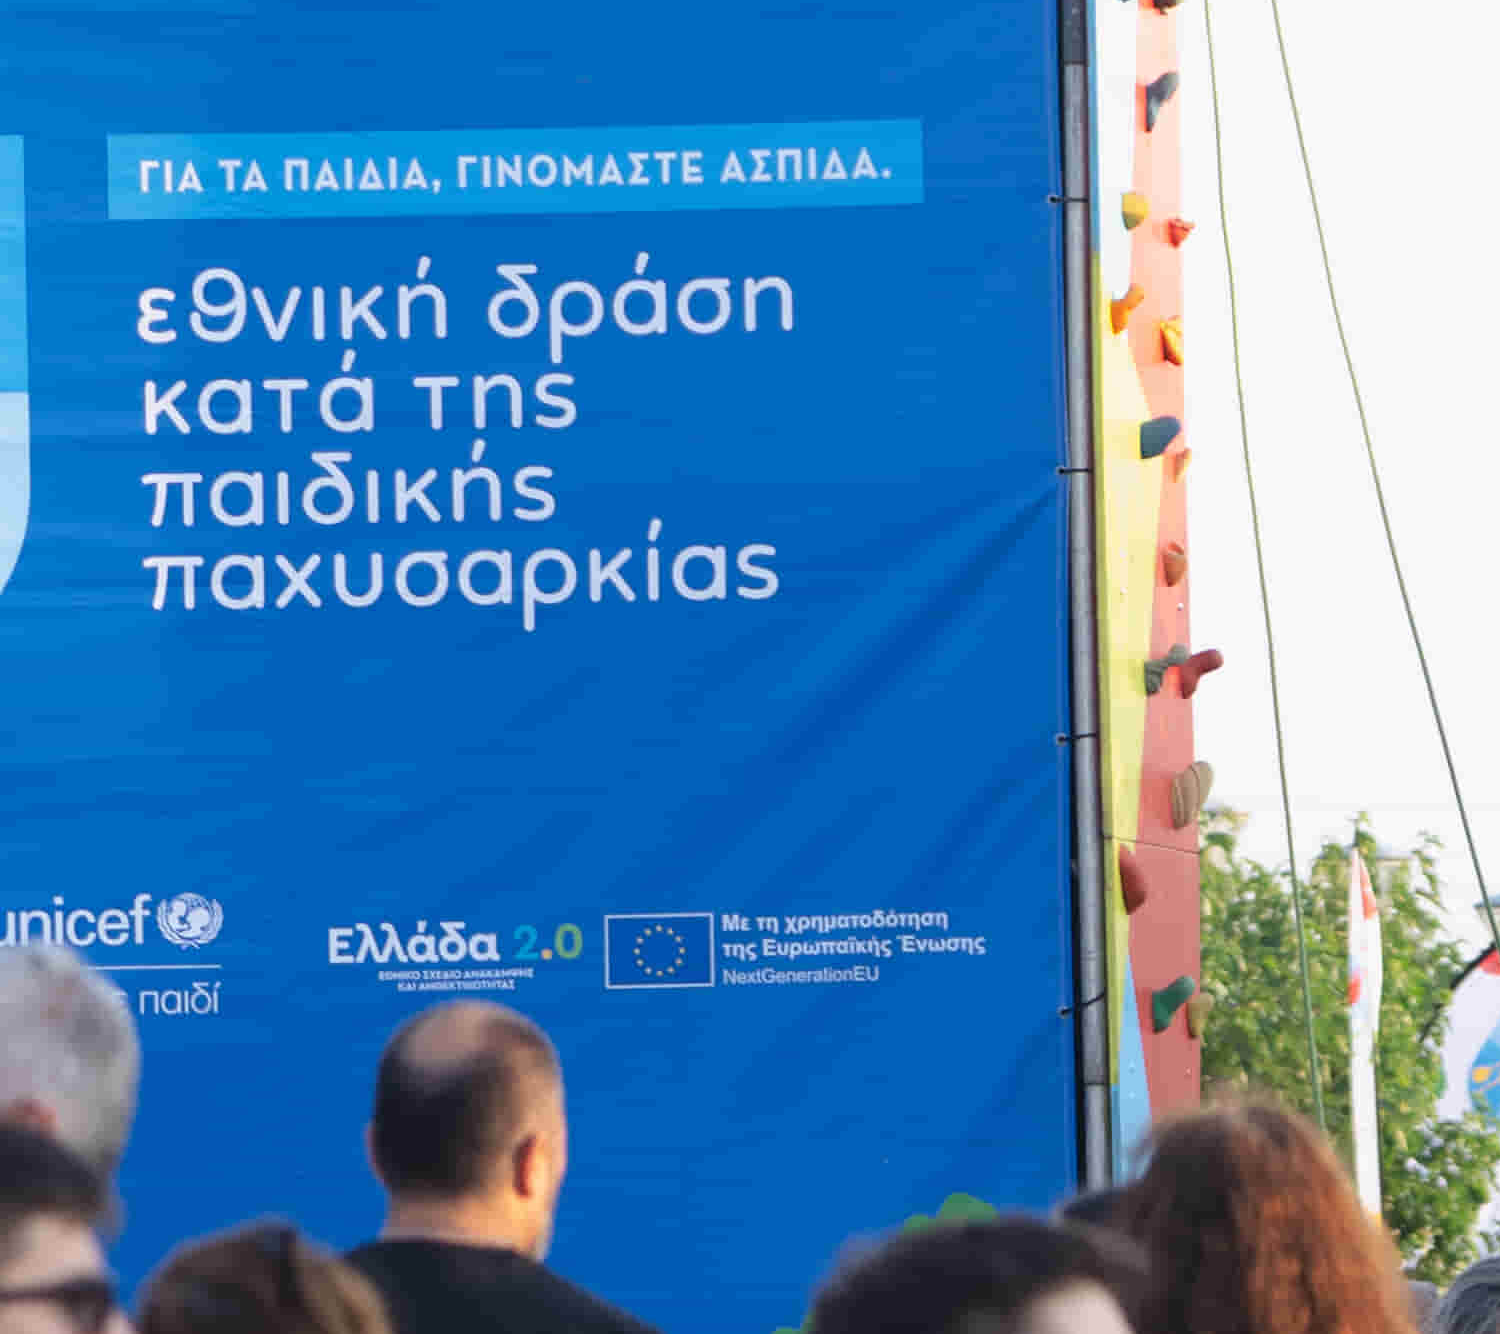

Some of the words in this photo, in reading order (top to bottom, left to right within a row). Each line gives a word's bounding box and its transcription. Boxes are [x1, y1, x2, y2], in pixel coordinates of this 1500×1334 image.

[139, 158, 203, 194] ΓΙΑ
[217, 158, 268, 193] ΤΑ
[283, 155, 442, 195] ΠΑΙΔΙΑ,
[456, 150, 705, 189] ΓΙΝΟΜΑΣΤΕ
[719, 146, 893, 183] ΑΣΠΙΔΑ.
[136, 255, 448, 344] εθνική
[487, 251, 795, 364] δράση
[142, 349, 375, 436] κατά
[412, 372, 578, 430] της
[140, 438, 557, 528] παιδικής
[141, 518, 780, 632] παχυσαρκίας
[327, 919, 502, 965] Ελλάδα
[513, 923, 583, 961] 2.0
[721, 913, 750, 933] Με
[755, 916, 779, 934] τη
[784, 909, 949, 935] χρηματοδότηση
[722, 942, 758, 961] της
[762, 935, 893, 960] Ευρωπαϊκής
[896, 935, 986, 956] Ένωσης
[139, 980, 222, 1015] παιδί
[722, 964, 881, 986] NextGenerationEU
